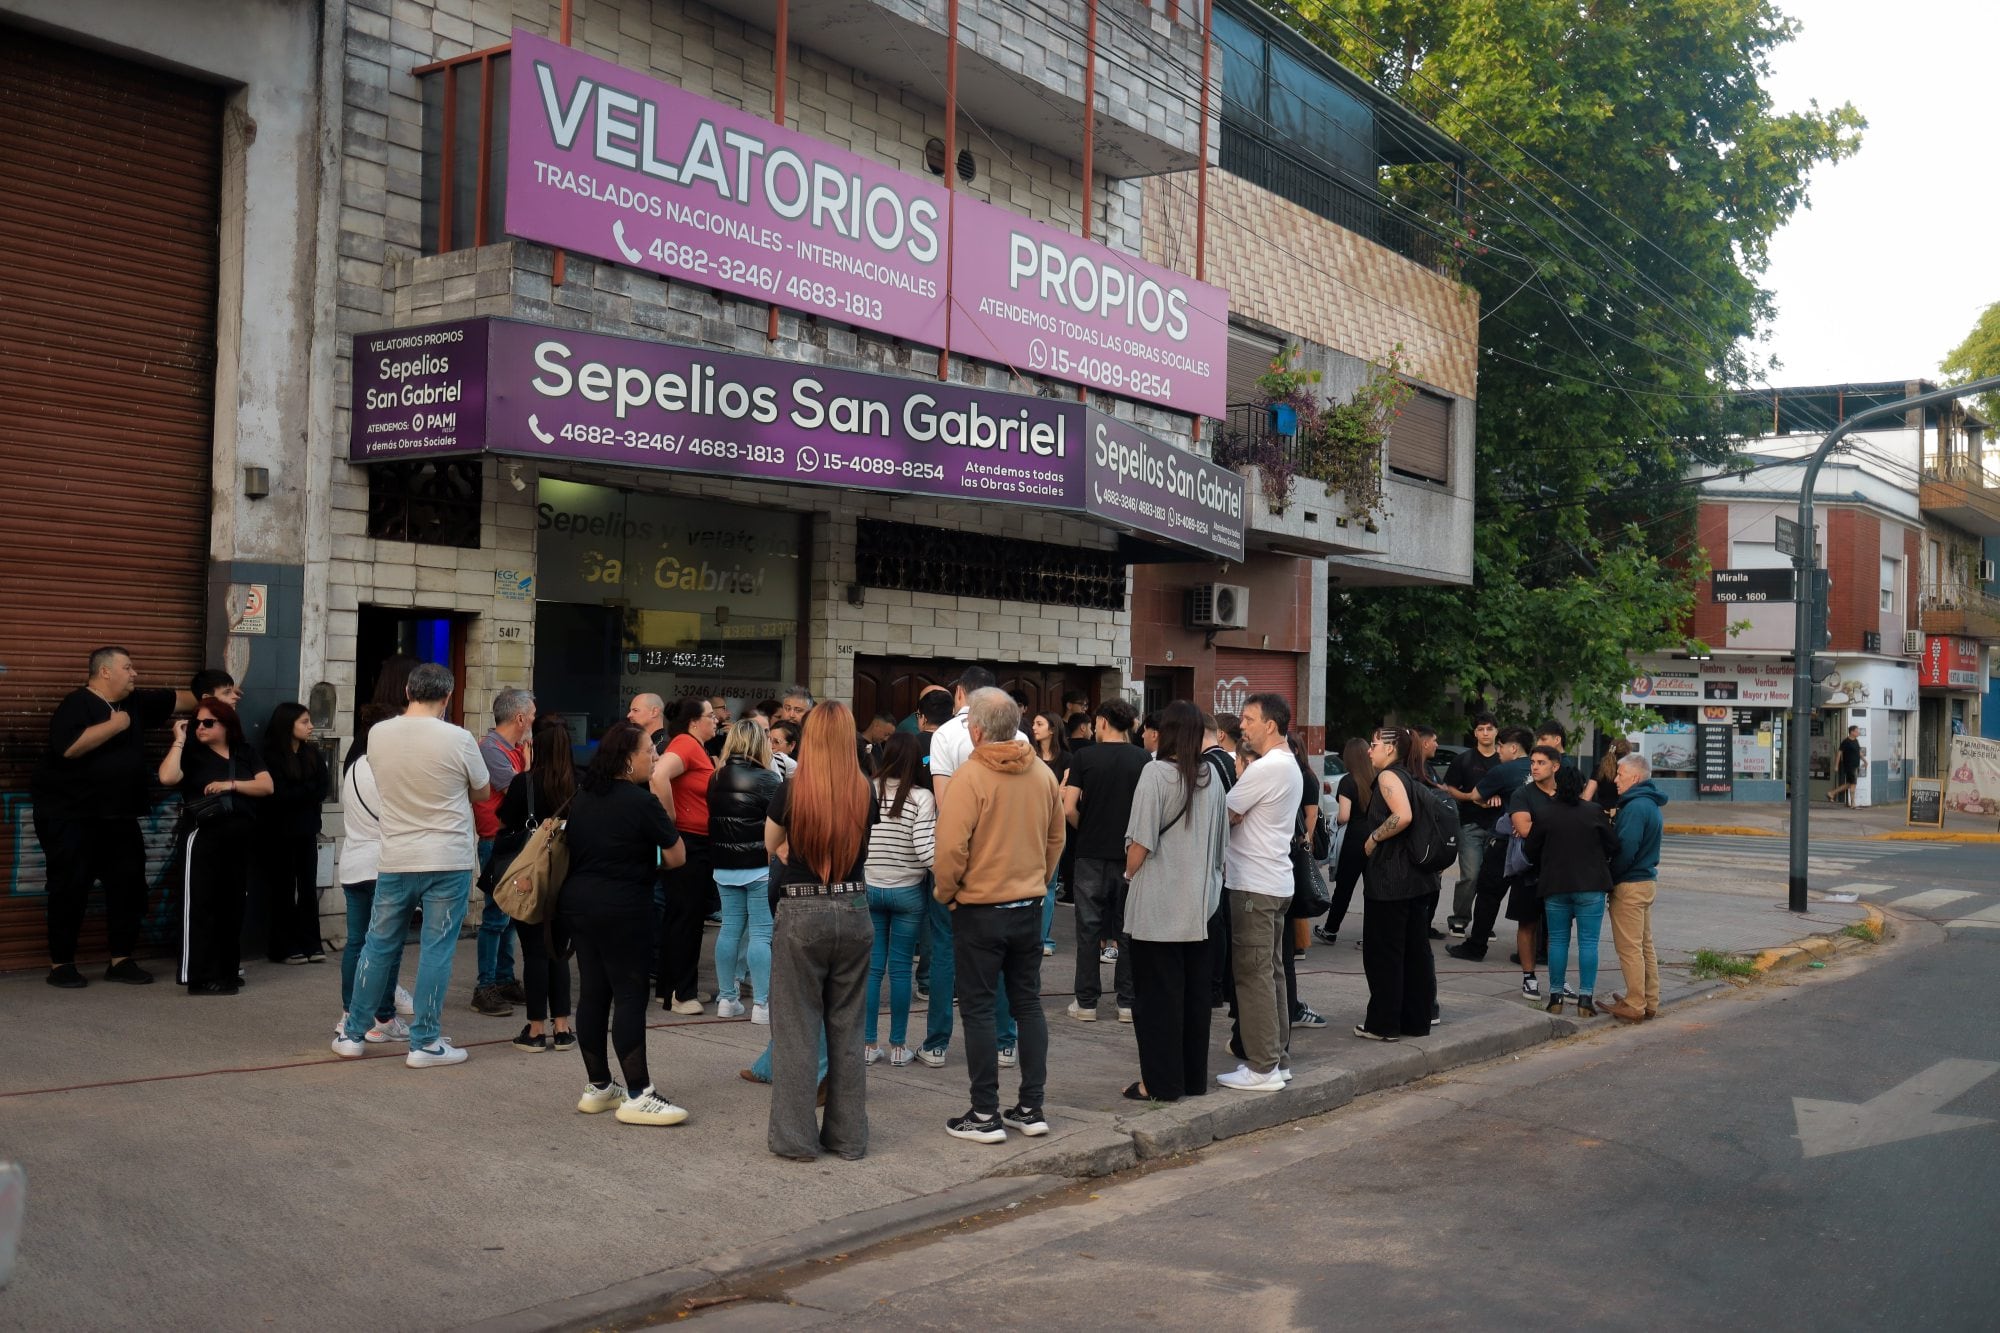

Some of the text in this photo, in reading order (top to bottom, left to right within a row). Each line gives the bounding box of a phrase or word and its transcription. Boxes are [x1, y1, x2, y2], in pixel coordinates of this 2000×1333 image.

[535, 62, 939, 264] VELATORIOS
[534, 160, 662, 217] TRASLADOS
[666, 201, 783, 252] NACIONALES
[797, 240, 937, 299] INTERNACIONALES
[648, 238, 883, 322] 4682-3246/ 4683-1813
[1010, 232, 1188, 340] PROPIOS
[370, 330, 464, 352] VELATORIOS PROPIOS
[978, 297, 1210, 377] ATENDEMOS TODAS LAS OBRAS SOCIALES
[380, 353, 449, 382] Sepelios
[1050, 346, 1171, 400] 15-4089-8254
[366, 380, 461, 410] San Gabriel
[531, 341, 1065, 457] Sepelios San Gabriel
[367, 412, 456, 434] ATENDEMOS: PAMI
[366, 436, 457, 453] y demás Obras Sociales
[688, 436, 785, 466] 4683-1813
[823, 452, 944, 480] 15-4089-8254
[965, 461, 1064, 483] Atendemos todas
[1095, 423, 1242, 519] Sepelios San Gabriel
[961, 475, 1064, 497] las Obras Sociales
[537, 502, 653, 541] Sepelios
[654, 556, 766, 596] Gabriel
[1716, 573, 1748, 582] Miralla
[1716, 593, 1737, 601] 1500
[1745, 592, 1767, 601] 1600
[499, 626, 521, 638] 5417
[1700, 663, 1726, 673] Fiambres
[1737, 664, 1757, 675] Quesos
[1755, 678, 1777, 687] Ventas
[1634, 677, 1648, 692] 42
[1743, 690, 1790, 700] Mayor y Menor
